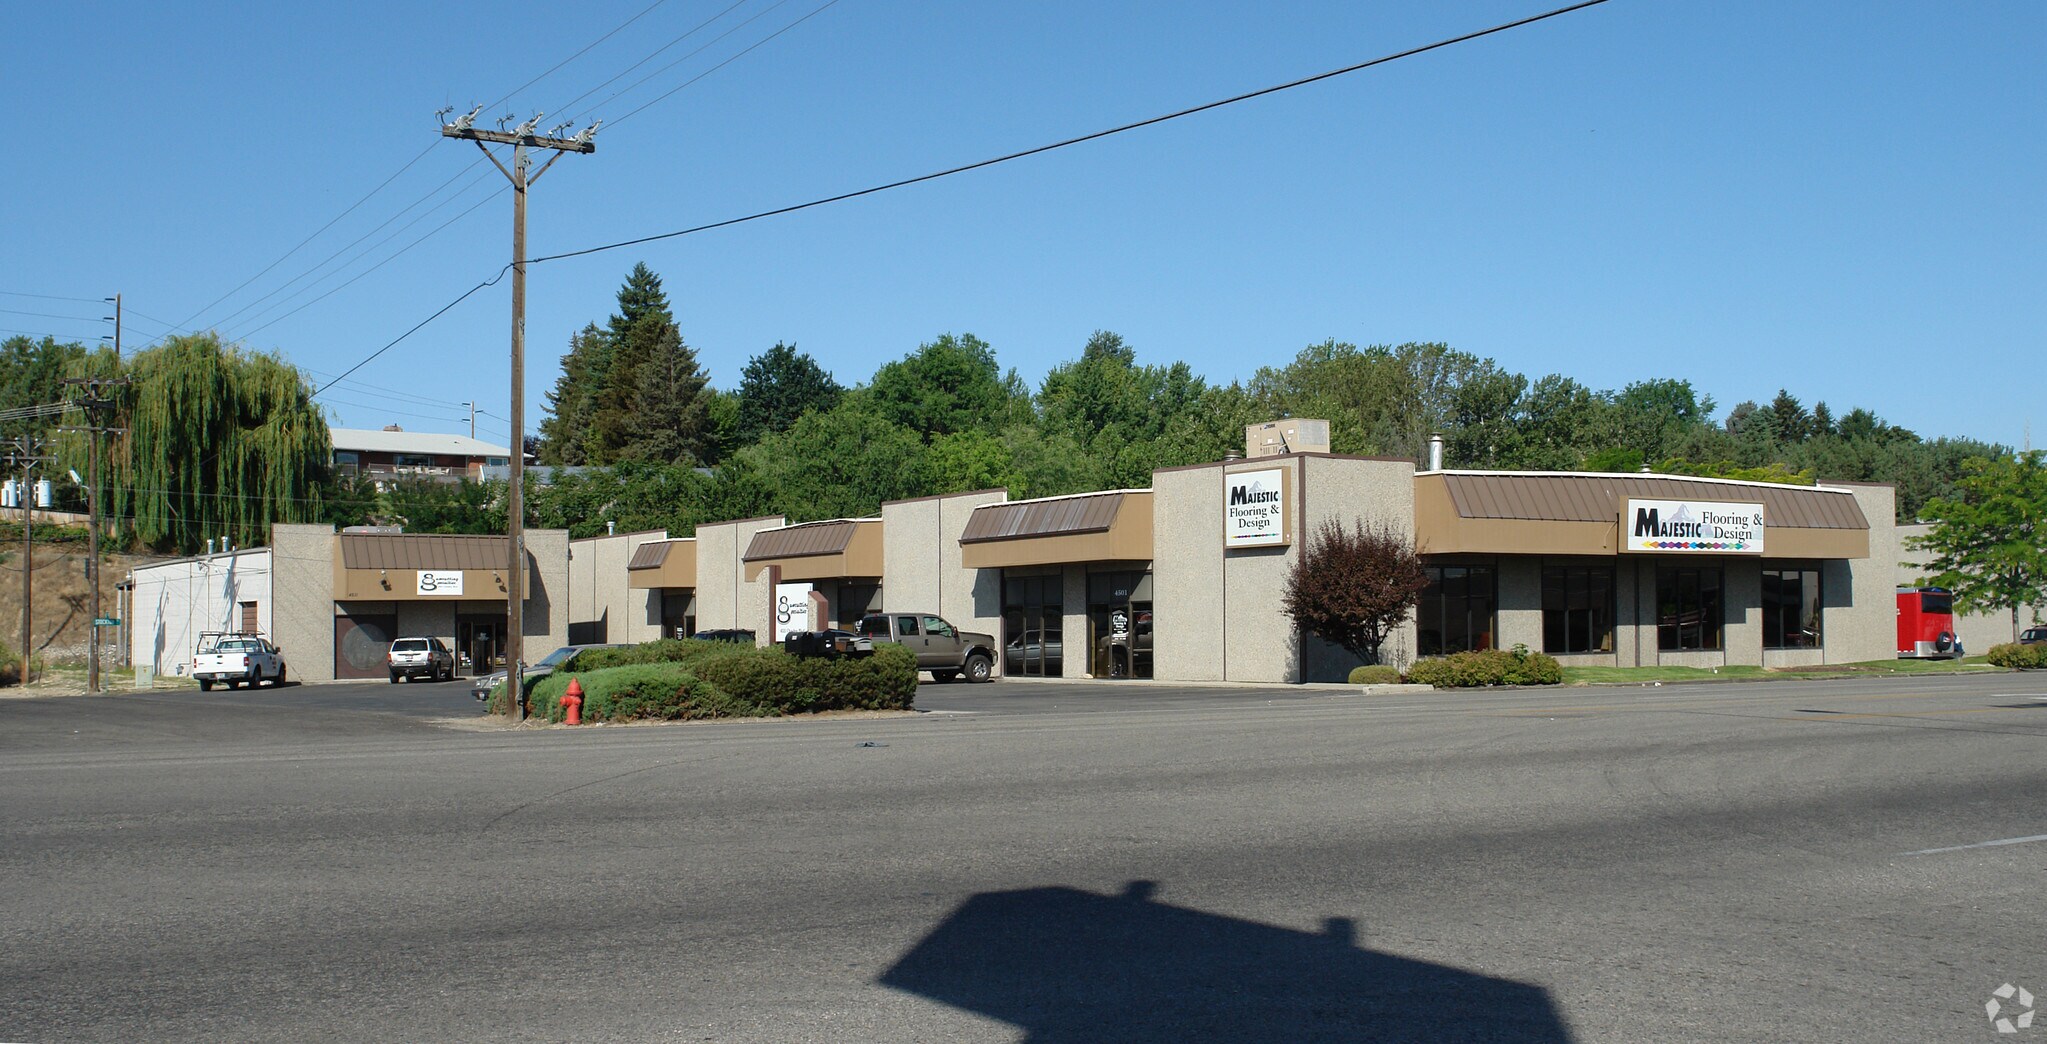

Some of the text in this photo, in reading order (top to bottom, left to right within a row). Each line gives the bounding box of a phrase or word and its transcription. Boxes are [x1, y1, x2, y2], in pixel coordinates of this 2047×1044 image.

[1230, 485, 1279, 506] MAJESTIC
[1229, 504, 1280, 518] Flooring &
[1238, 517, 1270, 530] Design
[1634, 507, 1701, 538] MAJESTIC
[1702, 511, 1763, 529] Flooring &
[1714, 526, 1752, 543] Design
